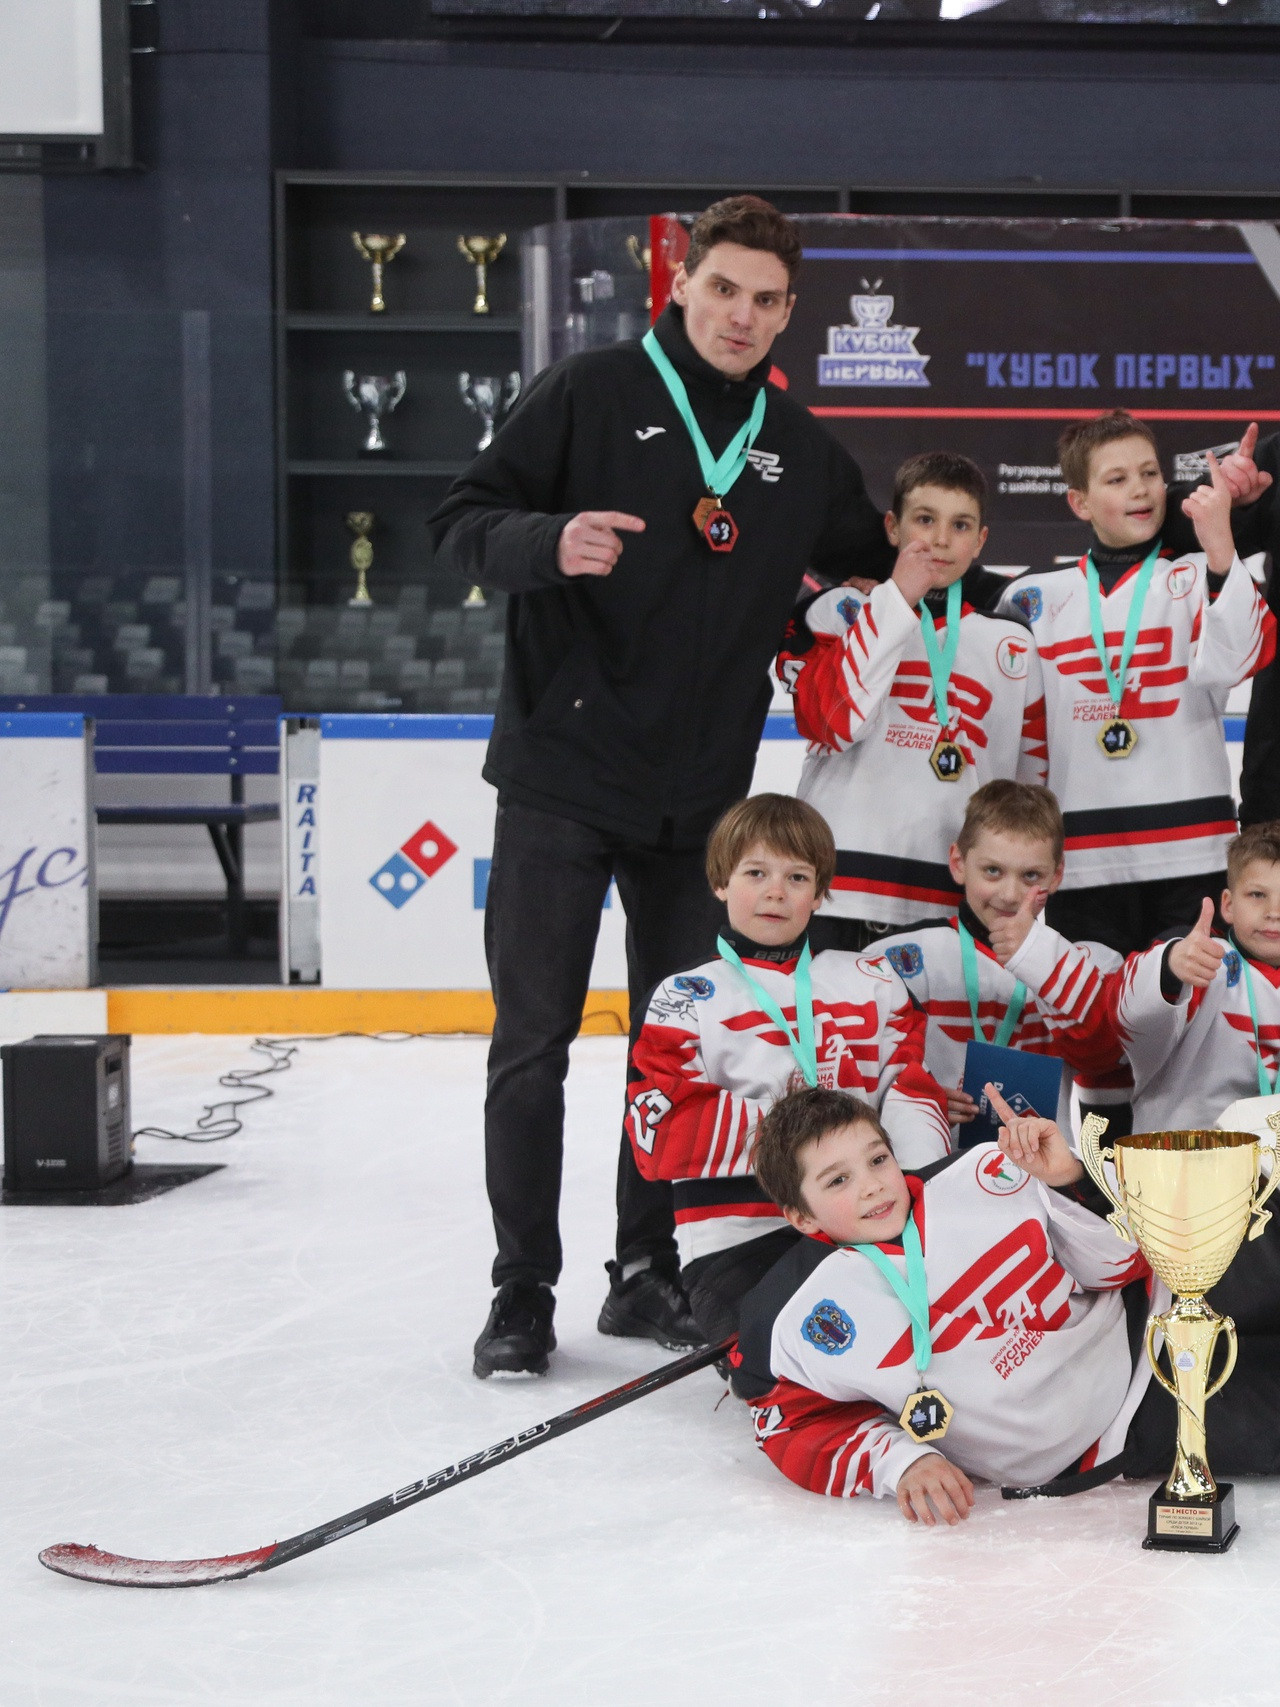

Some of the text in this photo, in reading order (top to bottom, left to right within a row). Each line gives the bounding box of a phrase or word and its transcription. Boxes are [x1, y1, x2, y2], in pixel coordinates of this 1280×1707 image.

[835, 331, 912, 353] КУБОК
[966, 353, 1276, 389] "КУБОК ПЕРВЫХ"
[297, 783, 317, 896] RAITA
[995, 1329, 1035, 1374] РУСЛАН
[1014, 1329, 1045, 1367] САЛЕЯ
